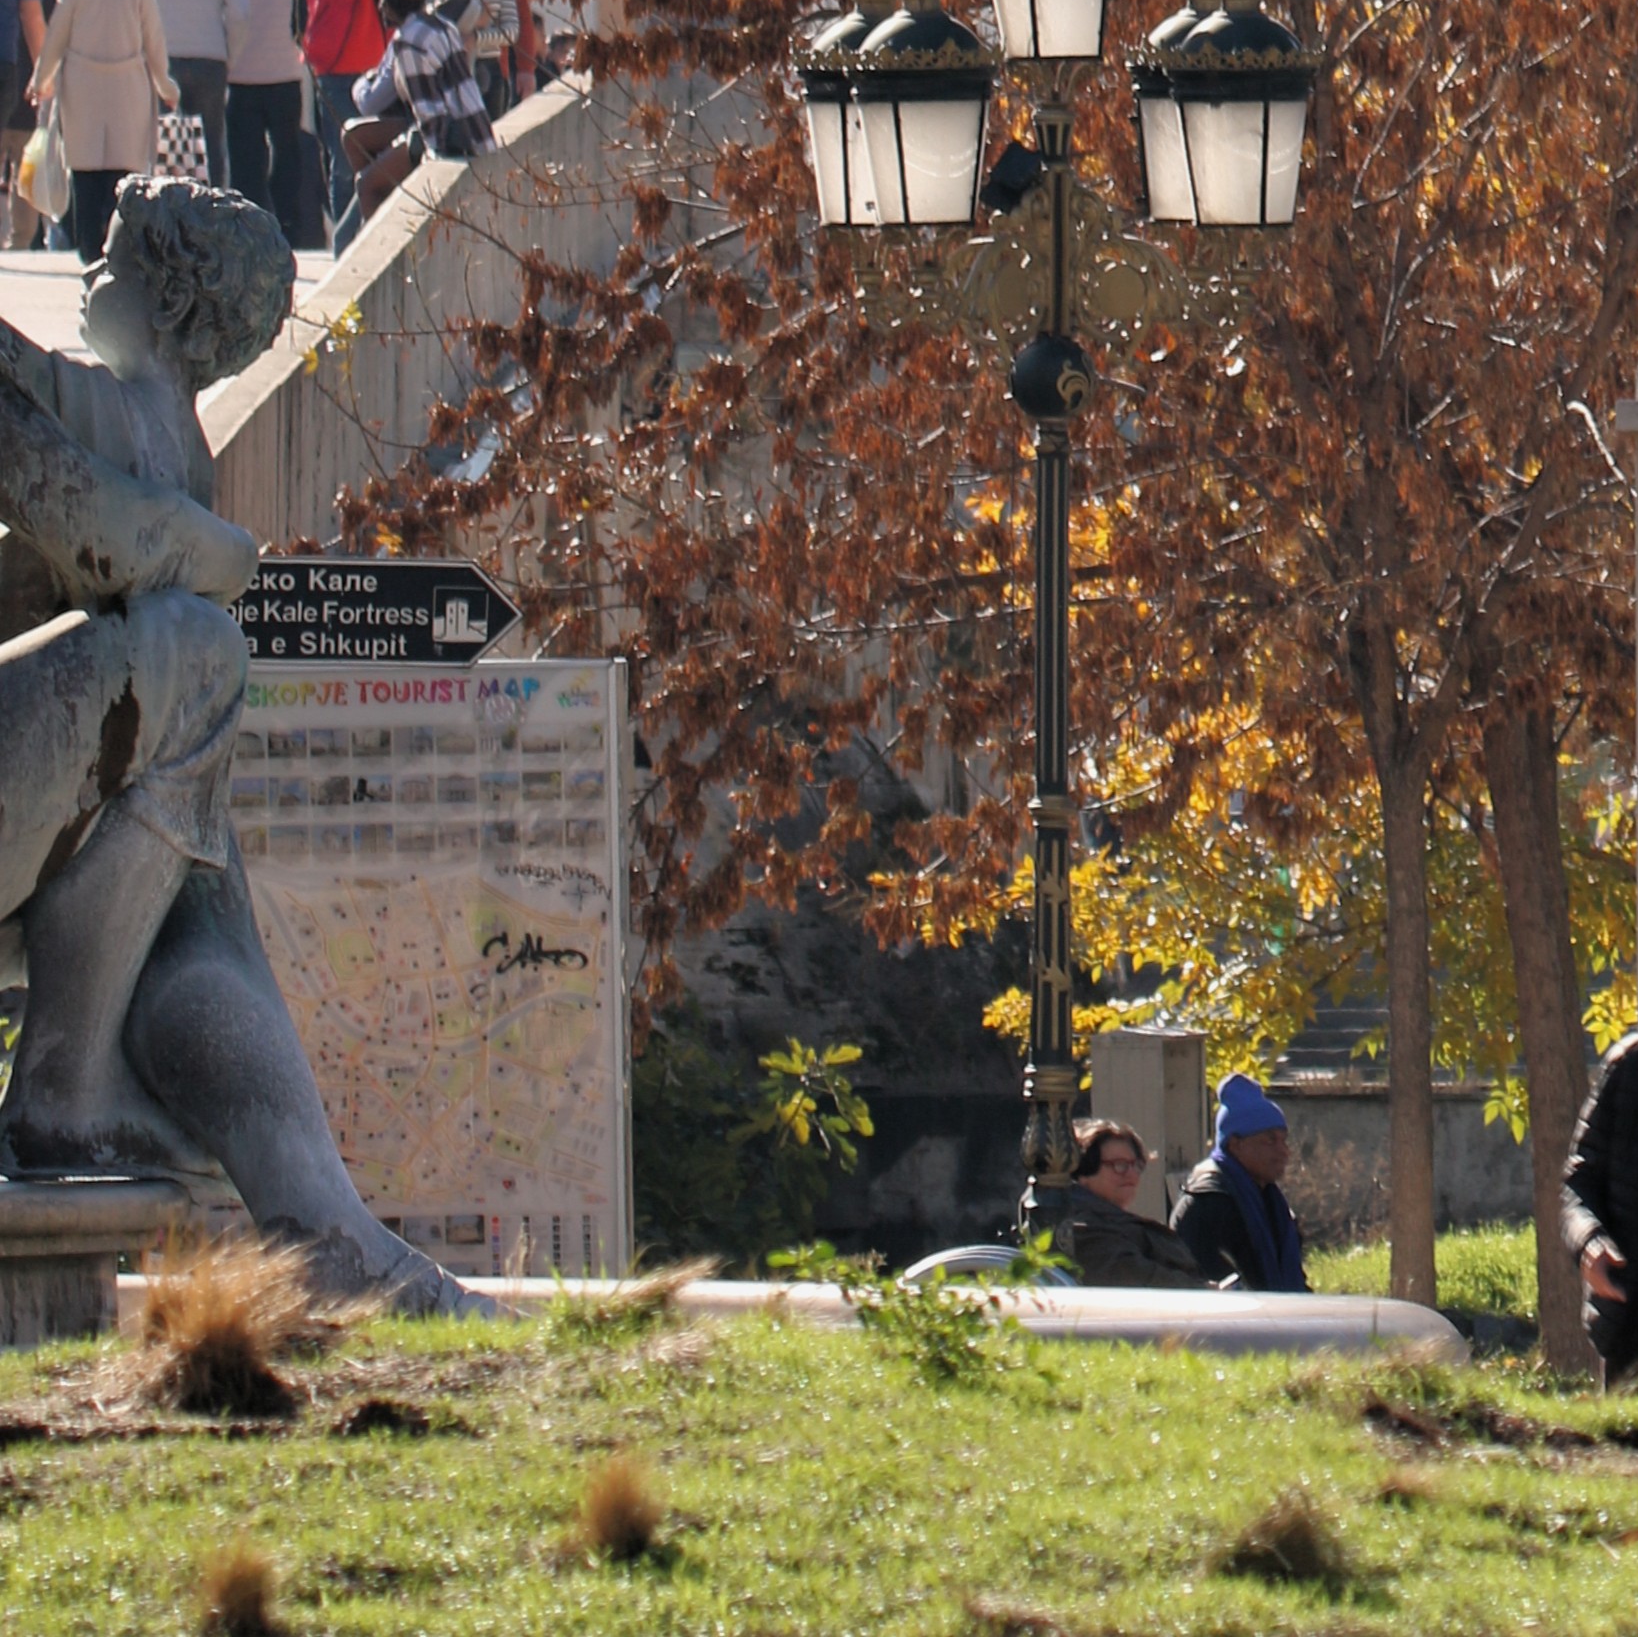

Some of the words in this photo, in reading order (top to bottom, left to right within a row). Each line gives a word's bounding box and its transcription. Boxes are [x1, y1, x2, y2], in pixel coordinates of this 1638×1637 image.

[309, 568, 378, 593] Кале
[263, 599, 318, 623] Kale
[323, 600, 429, 626] Fortress
[271, 636, 287, 655] e
[300, 631, 408, 661] Shkupit
[246, 680, 348, 708] SKOPJE
[354, 677, 471, 706] TOURIST
[479, 677, 541, 703] MAP
